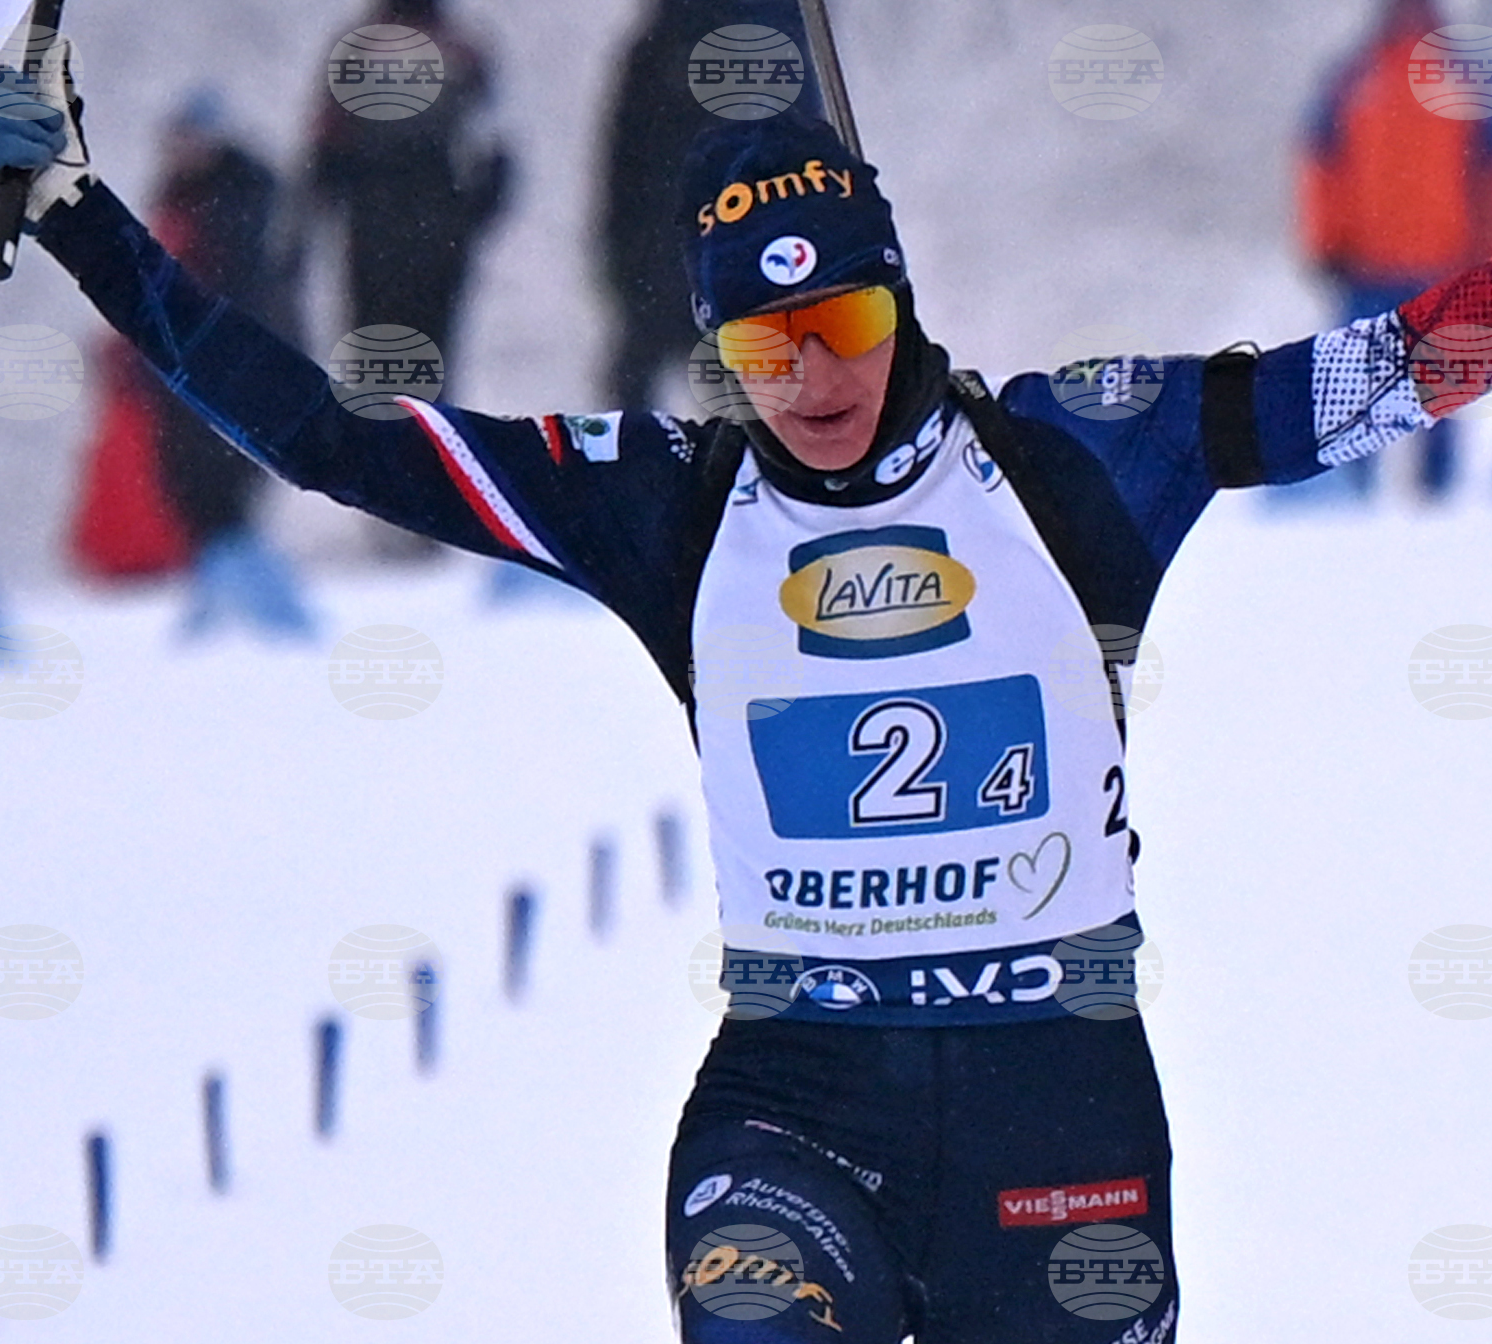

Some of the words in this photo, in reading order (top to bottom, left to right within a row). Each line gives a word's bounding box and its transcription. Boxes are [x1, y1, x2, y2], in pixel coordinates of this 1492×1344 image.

[696, 159, 854, 237] somfy
[848, 697, 948, 827] 2
[977, 743, 1035, 817] 4
[1102, 764, 1128, 838] 2
[764, 856, 1001, 910] OBERHOF
[870, 906, 998, 936] Deutschlands
